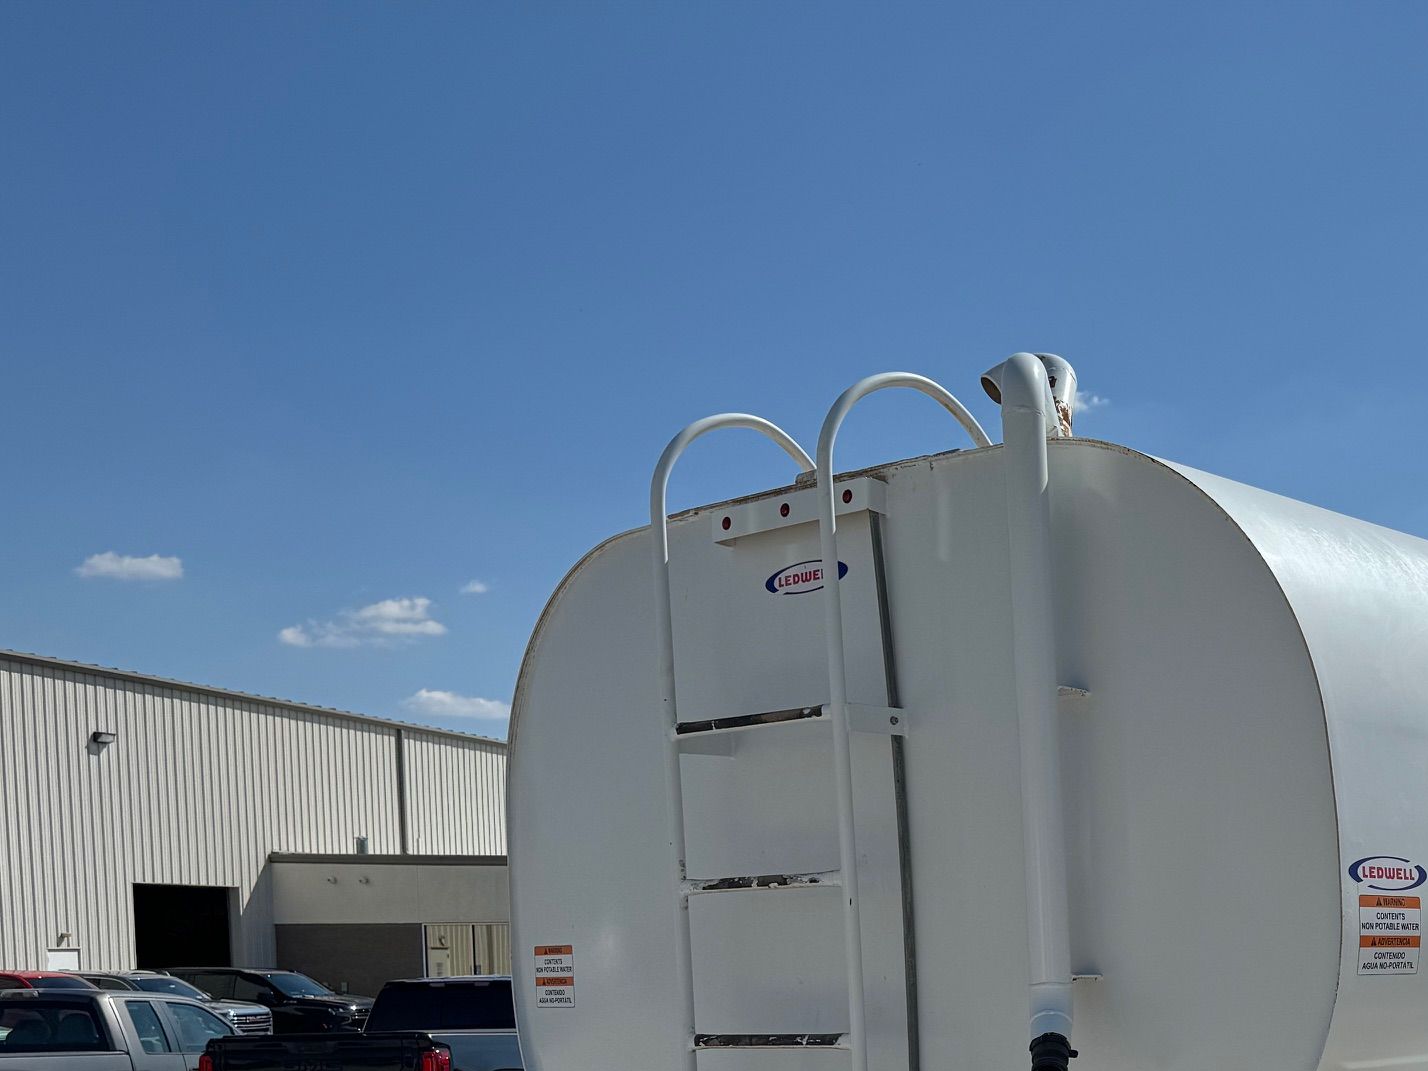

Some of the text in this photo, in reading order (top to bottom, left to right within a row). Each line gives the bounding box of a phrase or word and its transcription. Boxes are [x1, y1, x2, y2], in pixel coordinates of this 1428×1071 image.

[778, 569, 823, 588] LEDWE
[1362, 865, 1415, 881] LEDWELL
[1376, 912, 1406, 921] CONTENTS
[1361, 922, 1419, 932] NON POTABLE WATER
[1374, 951, 1406, 960] CONTENIDO
[1362, 962, 1378, 970] AGUA
